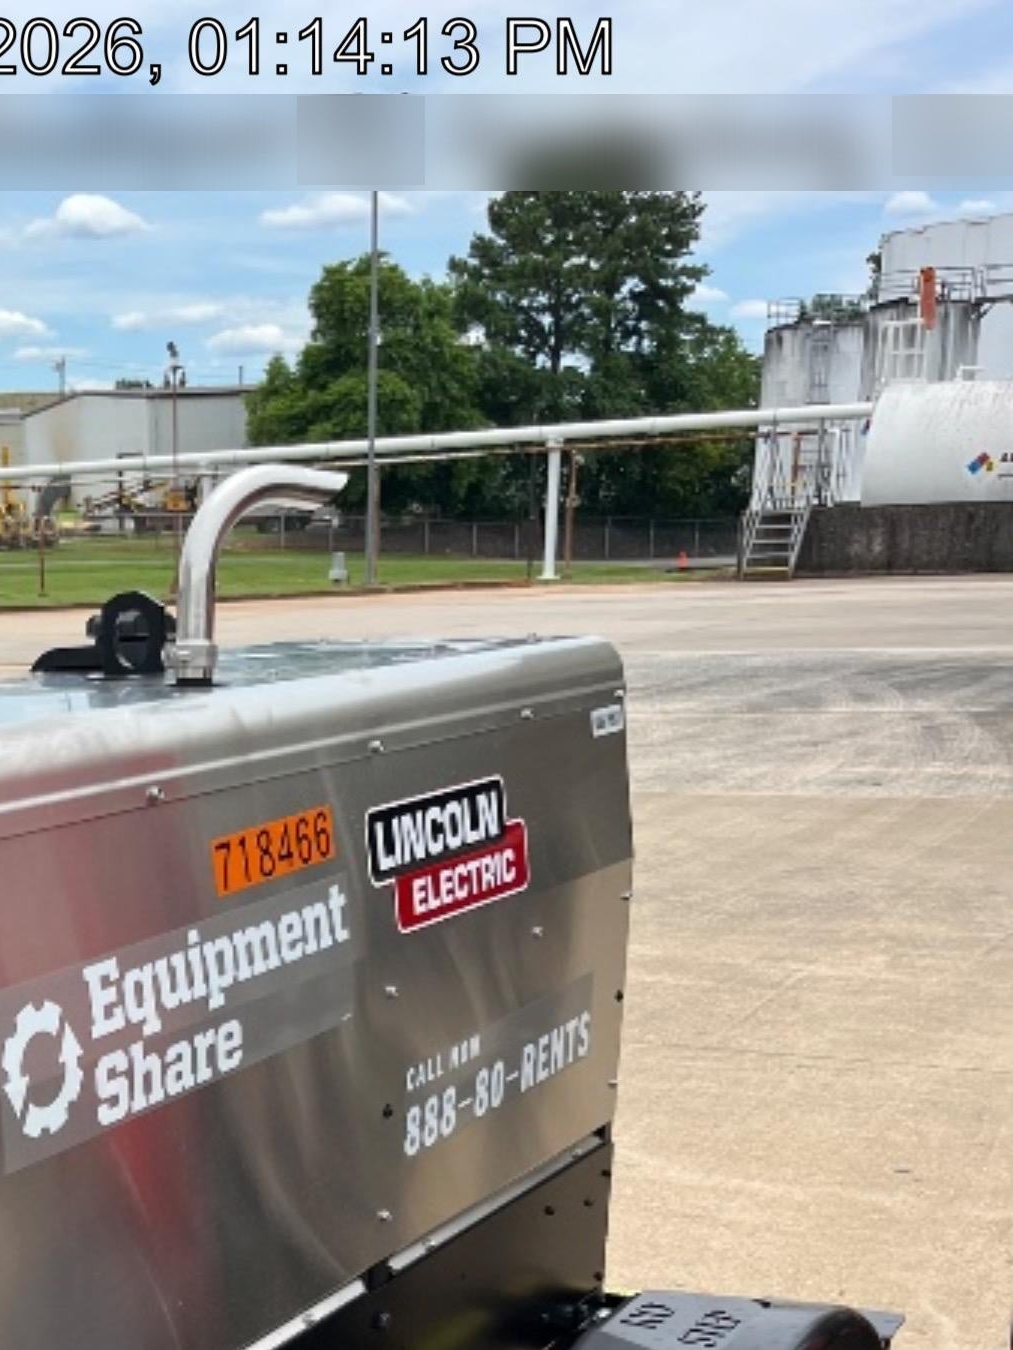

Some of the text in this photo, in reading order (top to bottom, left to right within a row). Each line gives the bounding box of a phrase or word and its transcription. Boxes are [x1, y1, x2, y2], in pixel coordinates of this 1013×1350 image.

[214, 810, 331, 891] 718466
[374, 789, 501, 872] LINCOLN
[411, 848, 517, 917] ELECTRIC
[82, 883, 350, 1040] Equipment
[93, 1018, 244, 1127] Share
[403, 1009, 592, 1157] 888-80-RENTS
[406, 1051, 445, 1091] CALL
